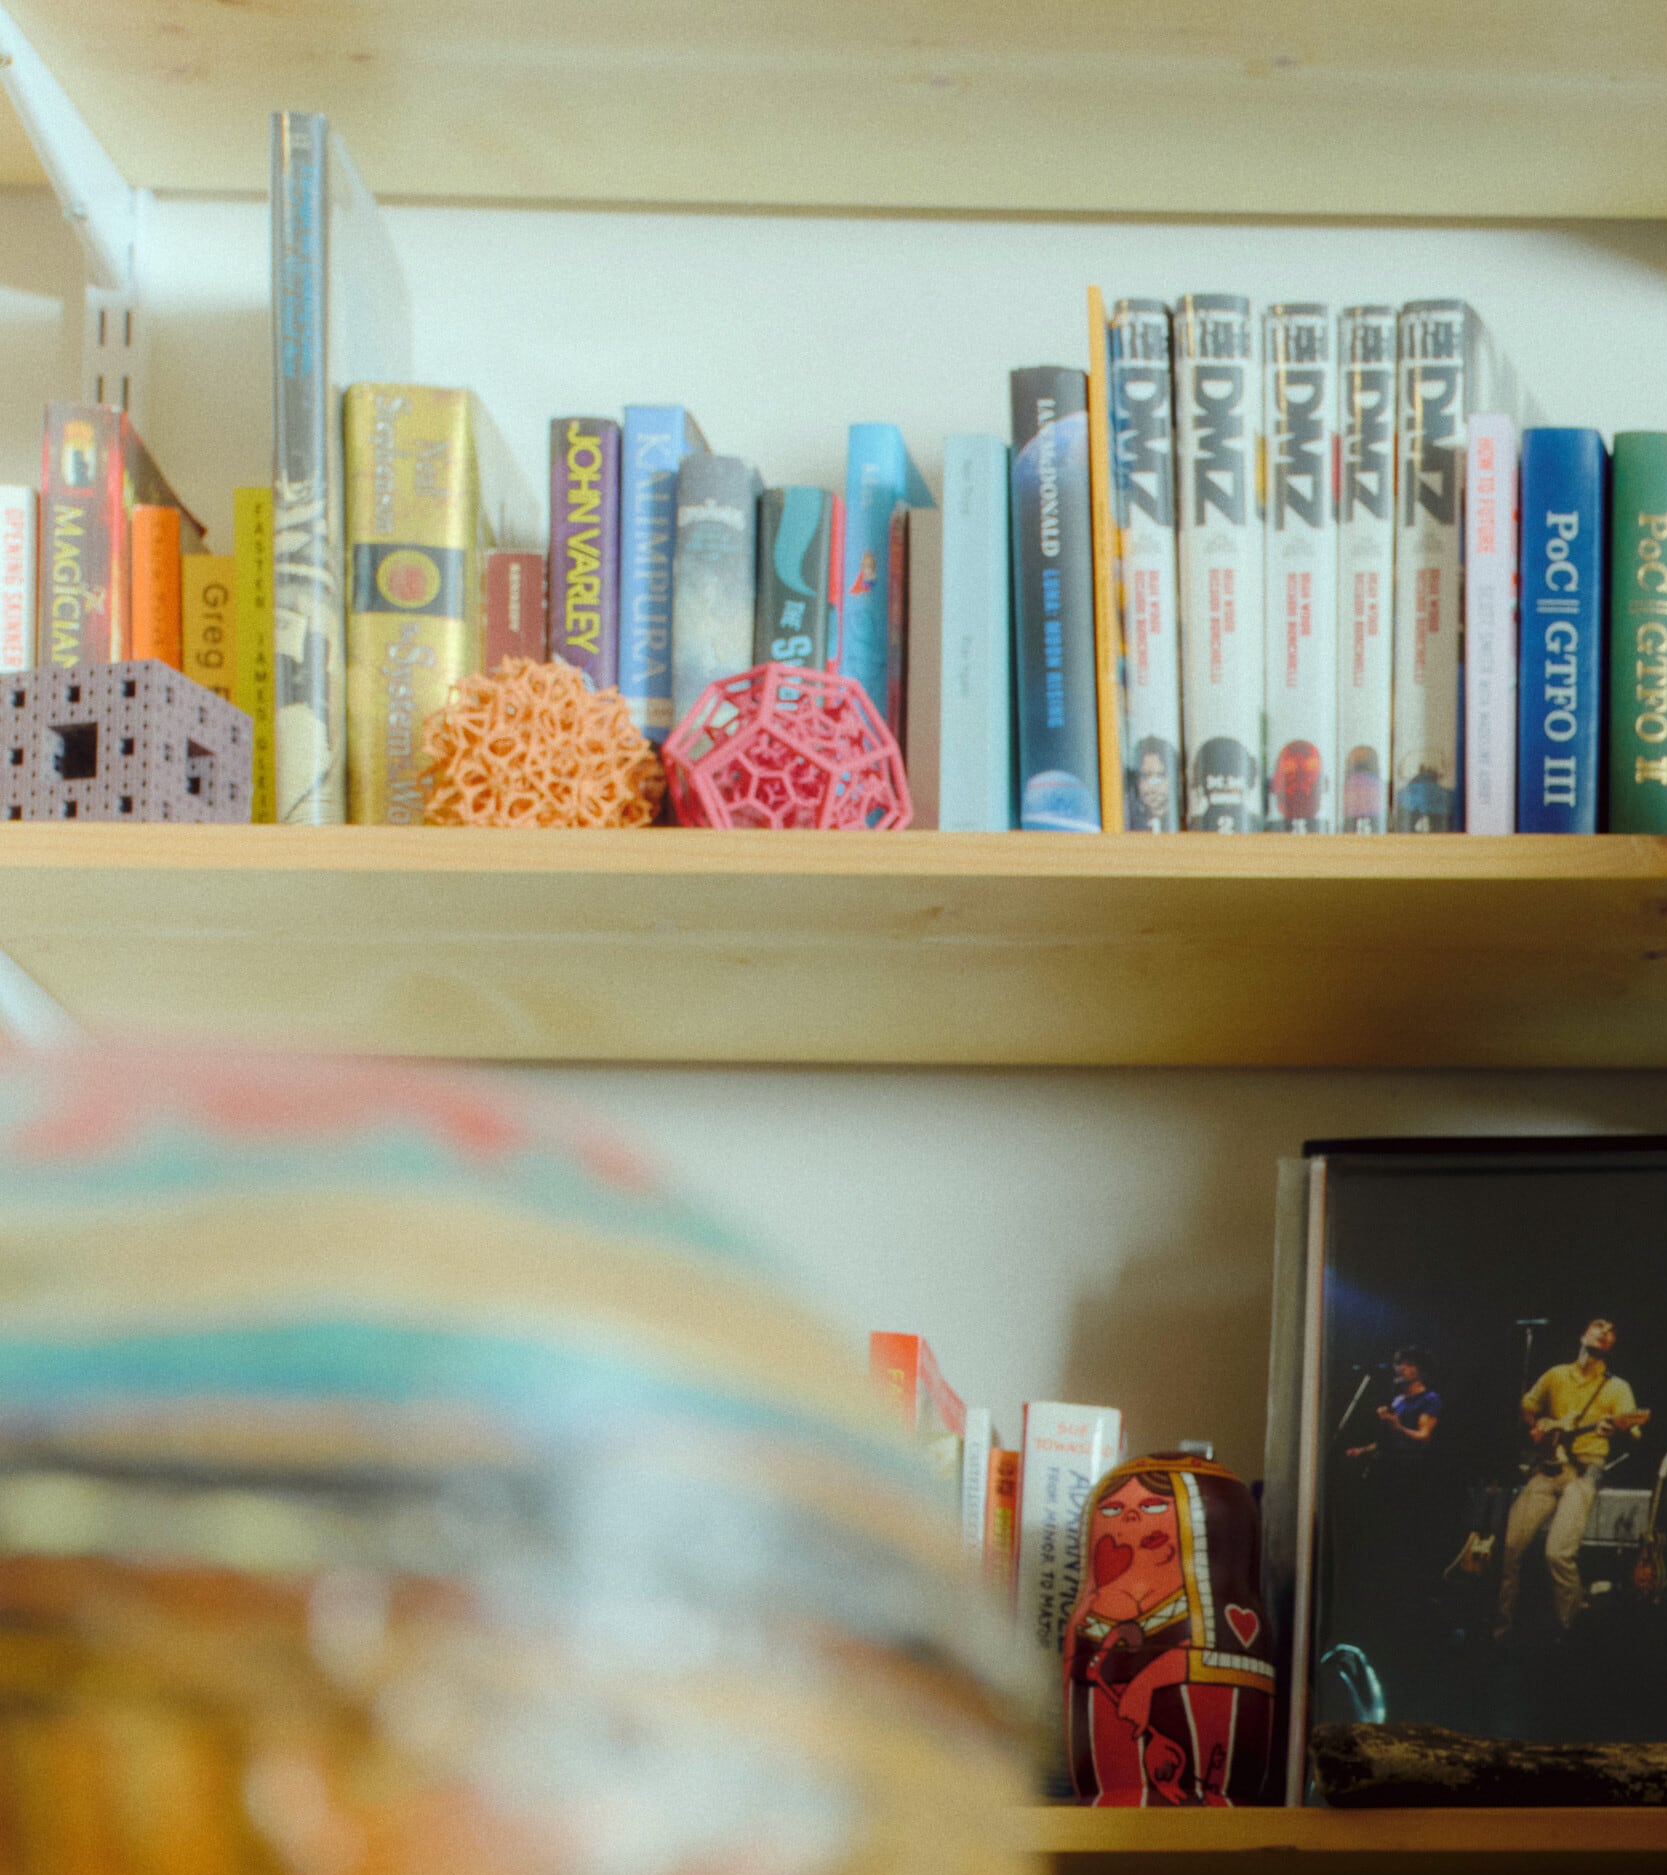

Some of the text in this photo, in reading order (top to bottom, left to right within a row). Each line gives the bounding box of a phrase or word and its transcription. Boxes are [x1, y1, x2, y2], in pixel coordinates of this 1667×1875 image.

[1117, 364, 1174, 529] DMZ
[1193, 364, 1246, 527] DMZ
[1273, 368, 1325, 531] DMZ
[1344, 369, 1392, 525] DMZ
[1404, 365, 1458, 528] DMZ
[565, 419, 603, 655] JOHN VARLEY
[630, 432, 674, 685] KALIMPURA
[196, 583, 229, 669] Greg
